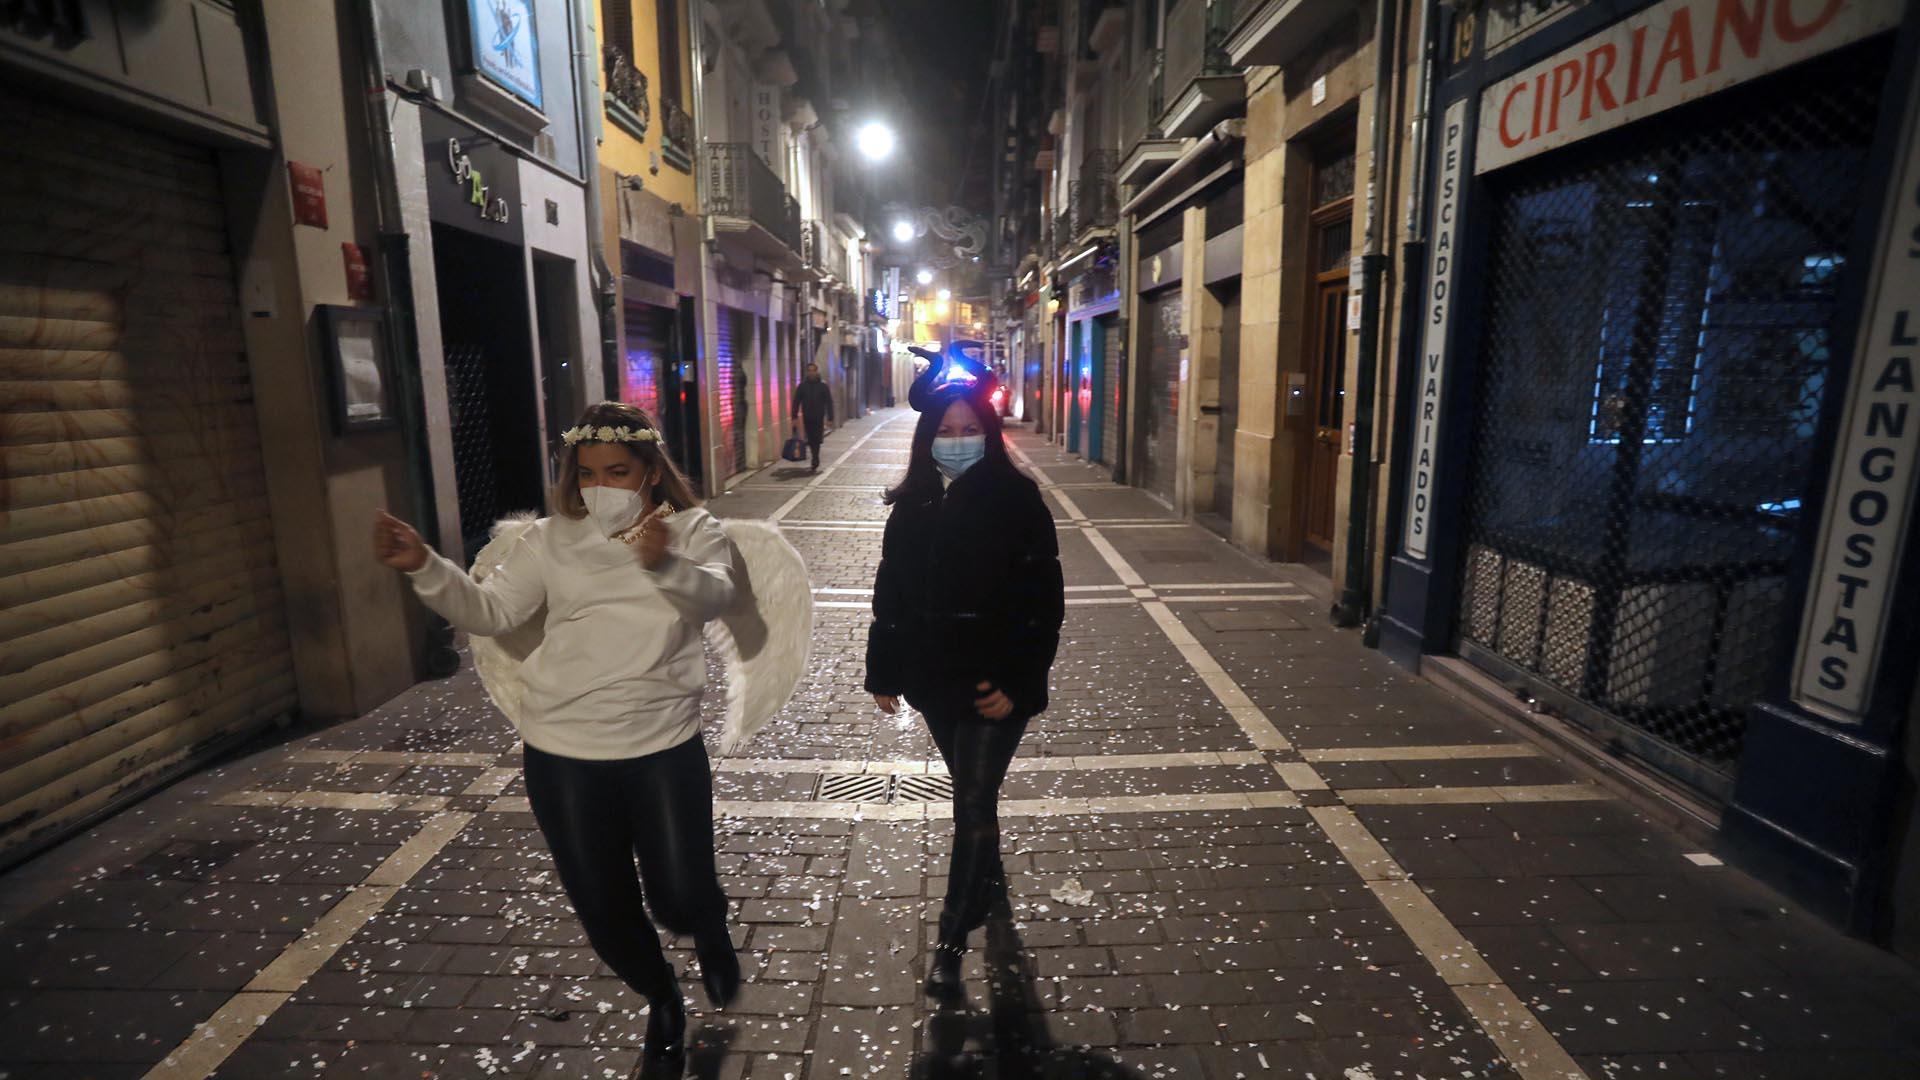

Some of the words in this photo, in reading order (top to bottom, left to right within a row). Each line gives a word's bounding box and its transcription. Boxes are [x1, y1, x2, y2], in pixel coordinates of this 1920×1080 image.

[1453, 12, 1477, 65] 19
[1432, 123, 1458, 325] PESCADOS
[1413, 353, 1440, 535] VARIADOS
[1818, 309, 1918, 692] LANGOSTAS
